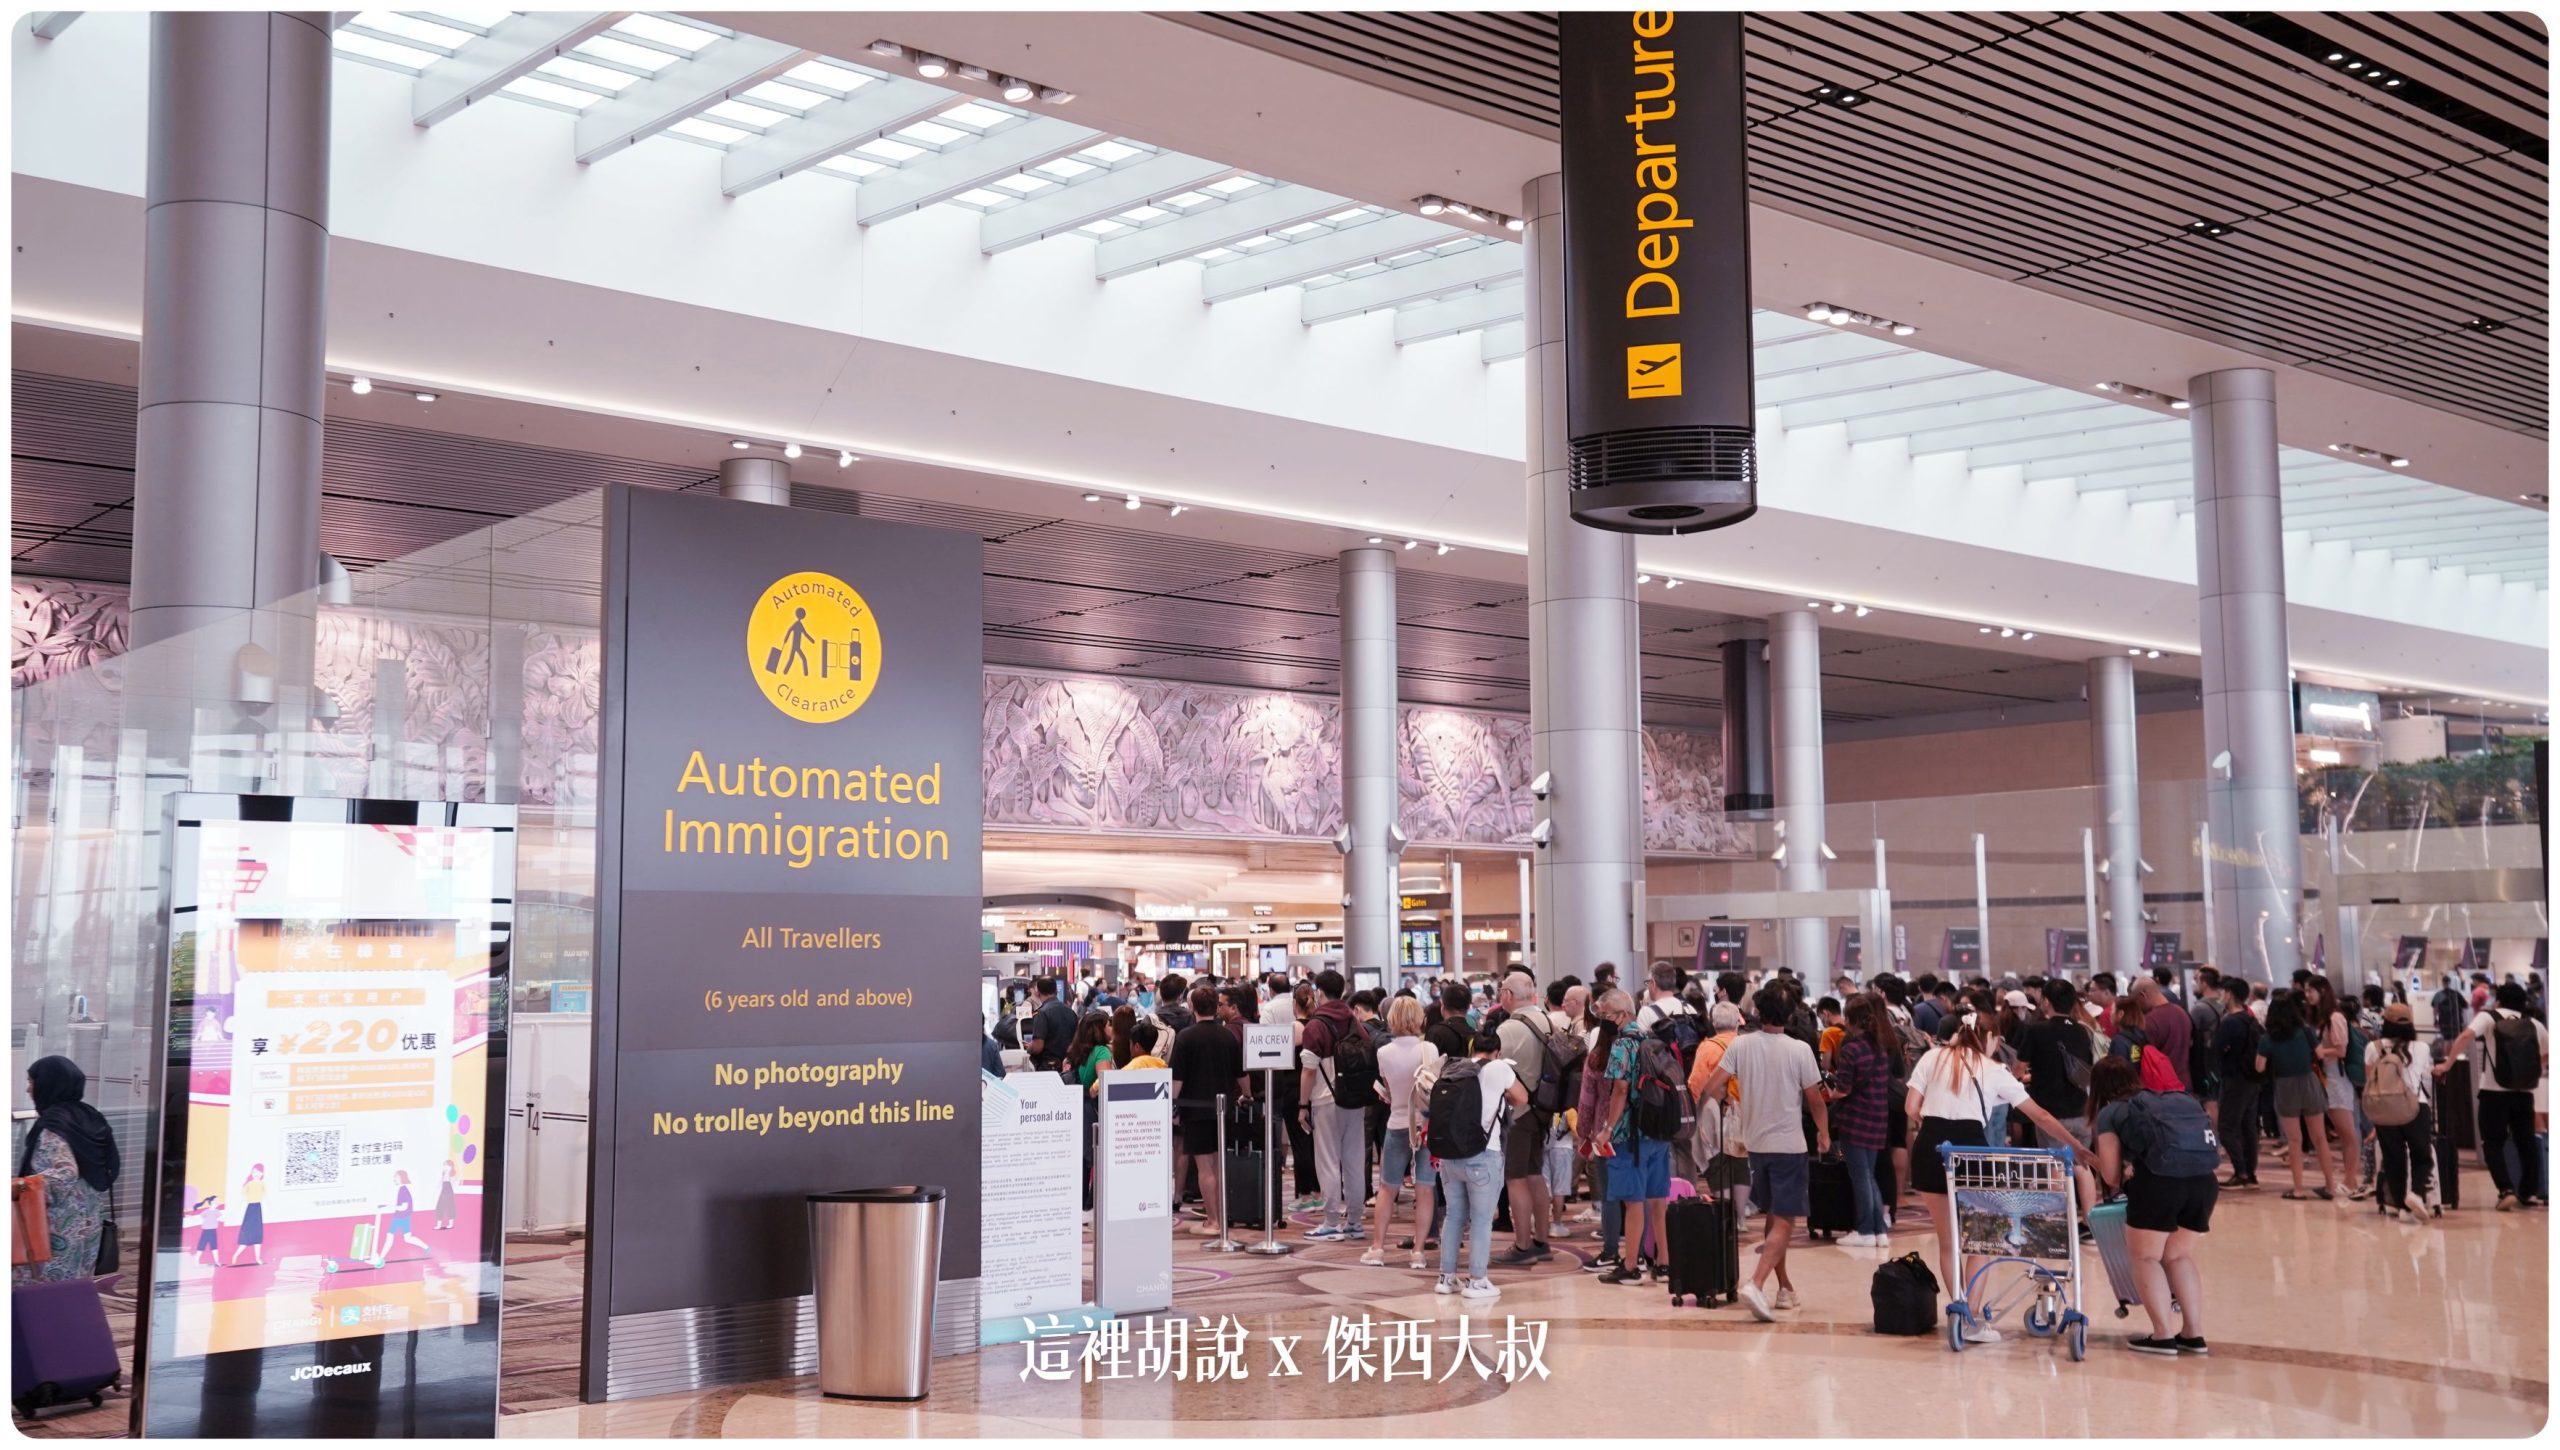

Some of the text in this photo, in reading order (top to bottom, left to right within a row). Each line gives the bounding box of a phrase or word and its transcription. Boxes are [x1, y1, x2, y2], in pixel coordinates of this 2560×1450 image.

[1625, 11, 1694, 319] Departure
[772, 583, 862, 618] Automated
[777, 683, 856, 712] Clearance
[677, 751, 941, 805] Automated
[664, 809, 949, 869] Immigration
[742, 927, 881, 949] All Travellers
[1007, 943, 1021, 952] Dior
[1464, 928, 1508, 941] GST Refund
[704, 987, 913, 1013] (6 years old and above)
[251, 1018, 437, 1056] 享 ¥220 优惠
[1250, 1034, 1290, 1045] AIR CREW
[715, 1058, 904, 1089] No photography
[1020, 1098, 1038, 1110] Your
[1020, 1109, 1072, 1126] personal data
[653, 1100, 955, 1136] No trolley beyond this line
[290, 1362, 372, 1381] JCDecaux
